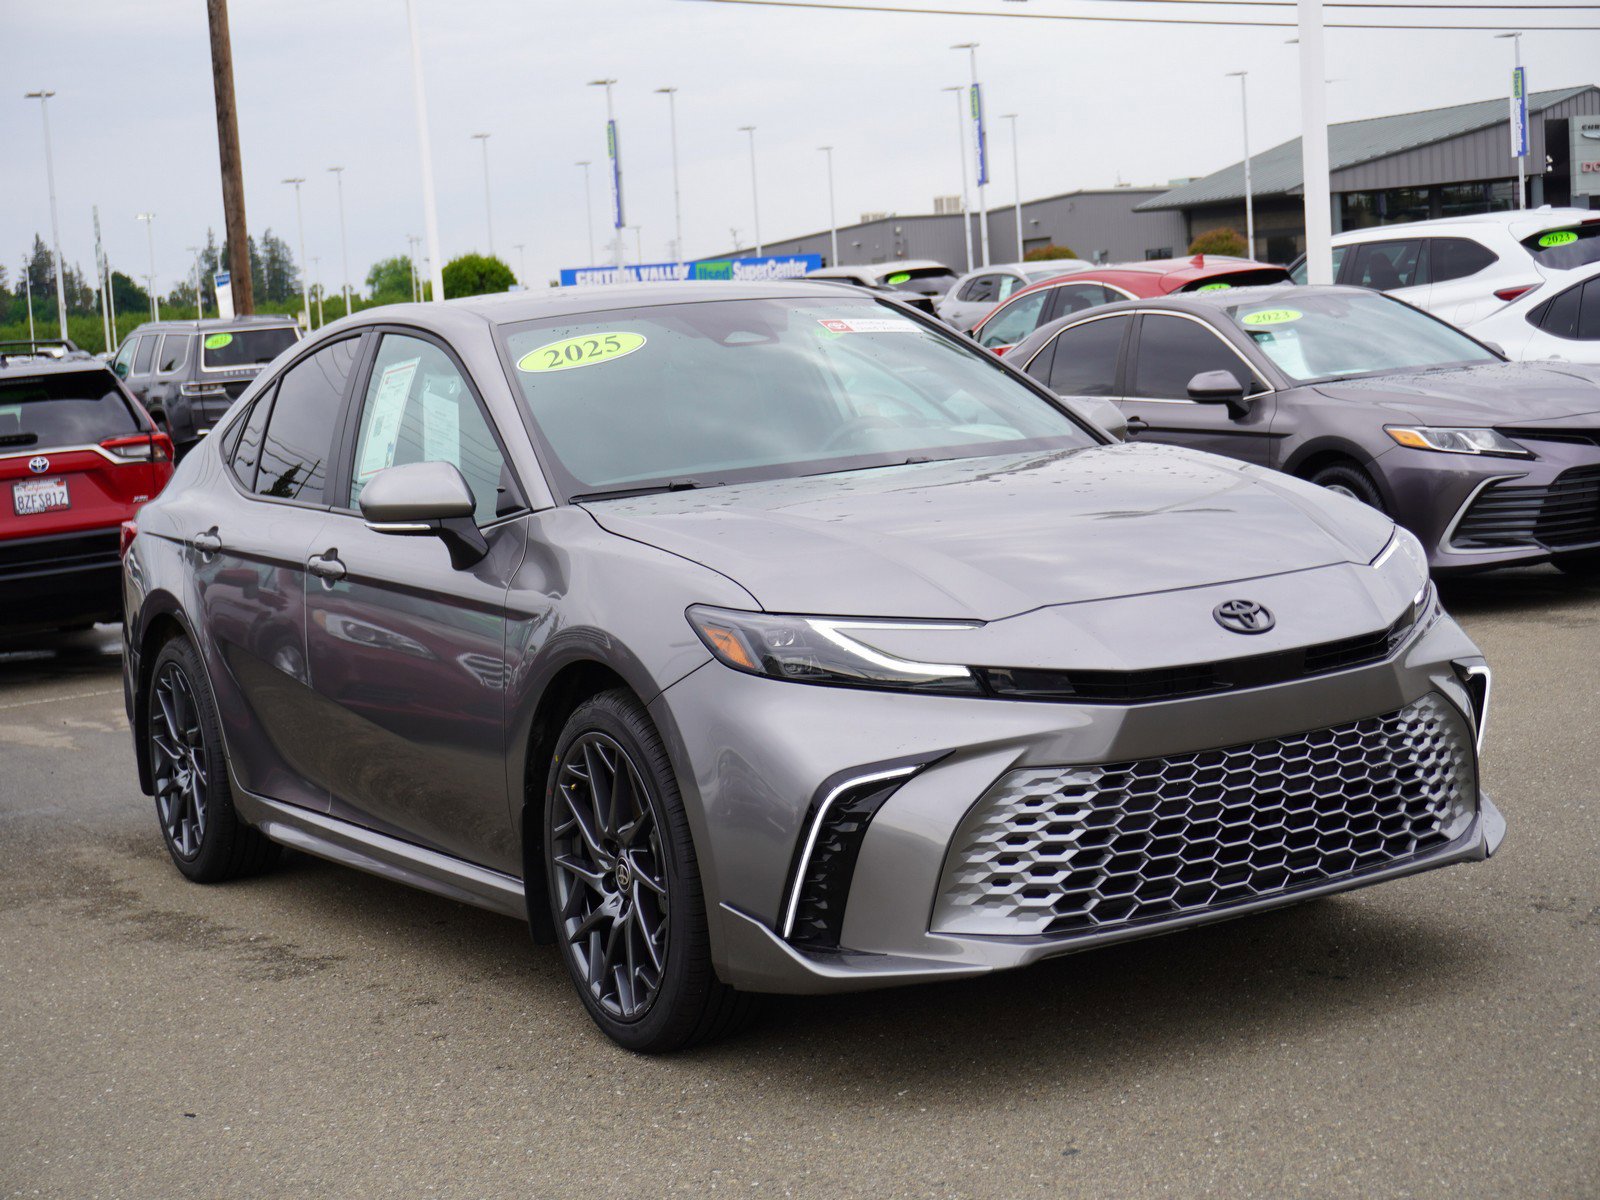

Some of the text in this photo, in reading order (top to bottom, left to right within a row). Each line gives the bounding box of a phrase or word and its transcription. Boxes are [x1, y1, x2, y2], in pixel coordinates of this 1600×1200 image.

[1546, 232, 1571, 246] 2023
[638, 263, 691, 281] VALLEY
[698, 266, 730, 280] Used
[732, 259, 808, 281] SuperCenter
[1253, 310, 1292, 324] 2023
[544, 335, 621, 368] 2025
